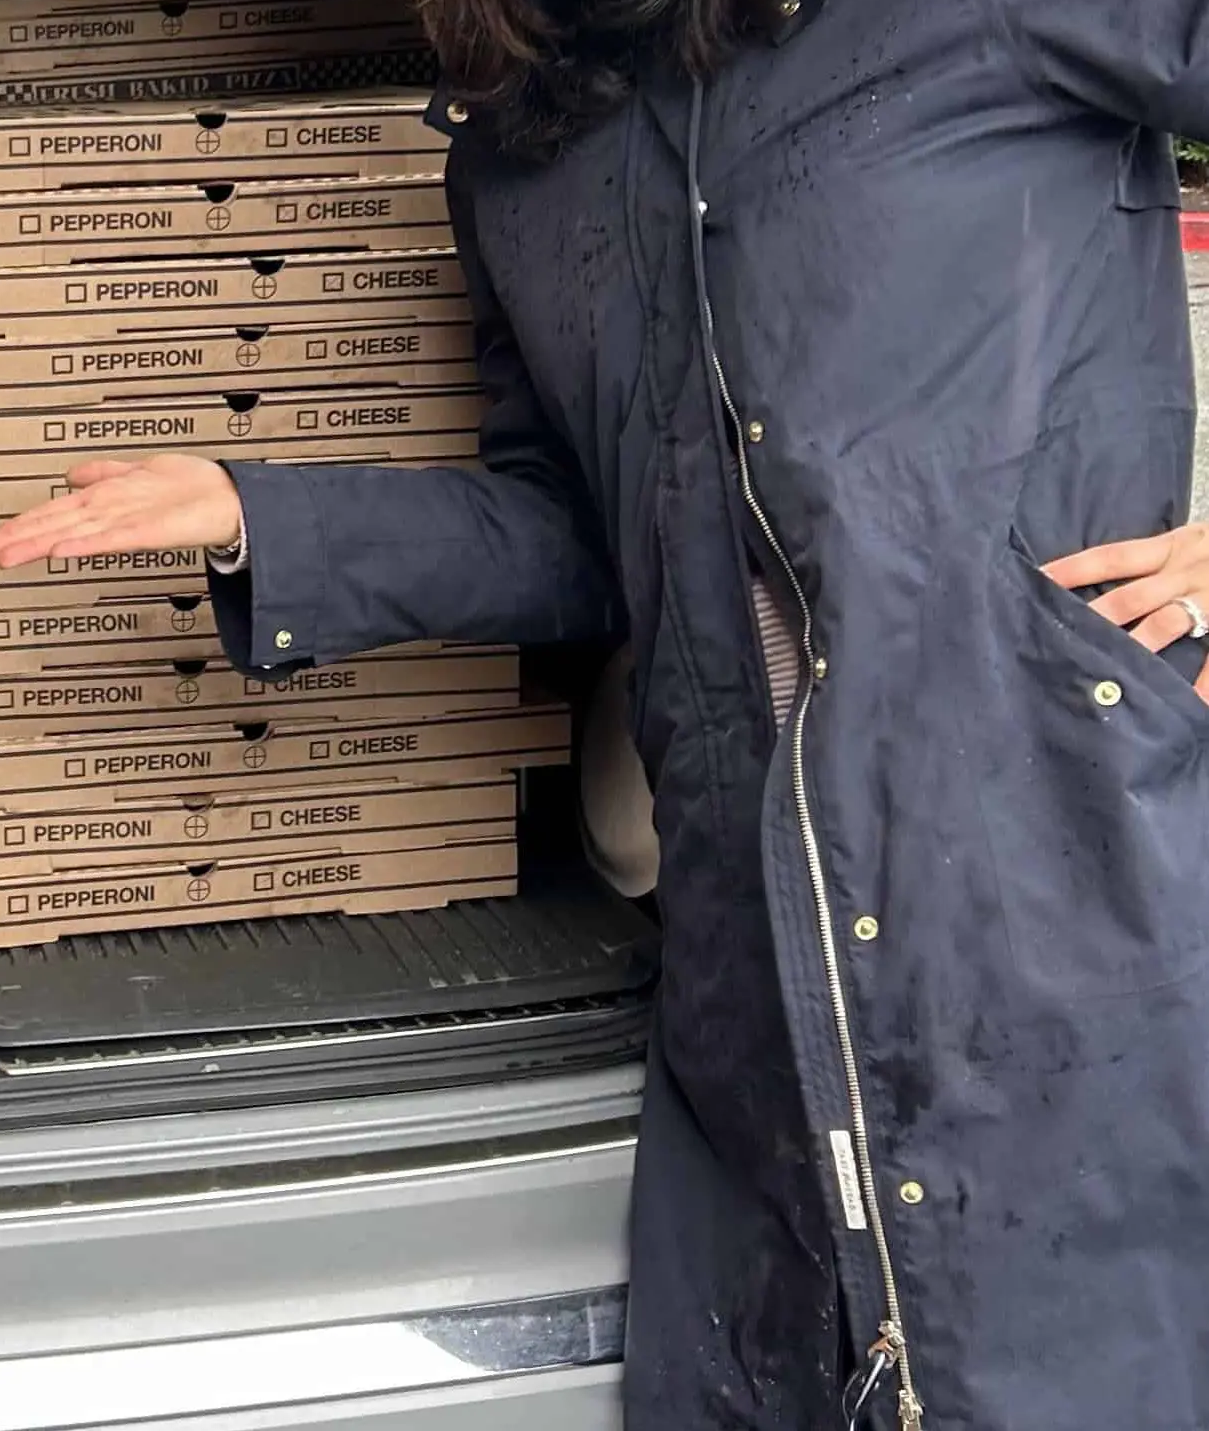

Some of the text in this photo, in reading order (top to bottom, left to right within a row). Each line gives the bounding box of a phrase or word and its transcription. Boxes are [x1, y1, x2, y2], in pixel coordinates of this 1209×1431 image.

[33, 6, 315, 41] PEPPERONI CHEESE
[38, 71, 294, 101] FRESH BAKED PIZZA
[39, 124, 381, 155] PEPPERONI CHEESE
[49, 199, 391, 232] PEPPERONI CHEESE
[95, 269, 439, 301] PEPPERONI CHEESE
[81, 334, 421, 371] PEPPERONI CHEESE
[73, 404, 411, 440] PEPPERONI CHEESE
[76, 549, 198, 572] PEPPERONI
[18, 612, 139, 637] PEPPERONI
[22, 670, 357, 708] PEPPERONI CHEESE
[93, 733, 418, 777] PEPPERONI CHEESE
[33, 804, 361, 843] PEPPERONI CHEESE
[37, 864, 361, 913] PEPPERONI CHEESE
